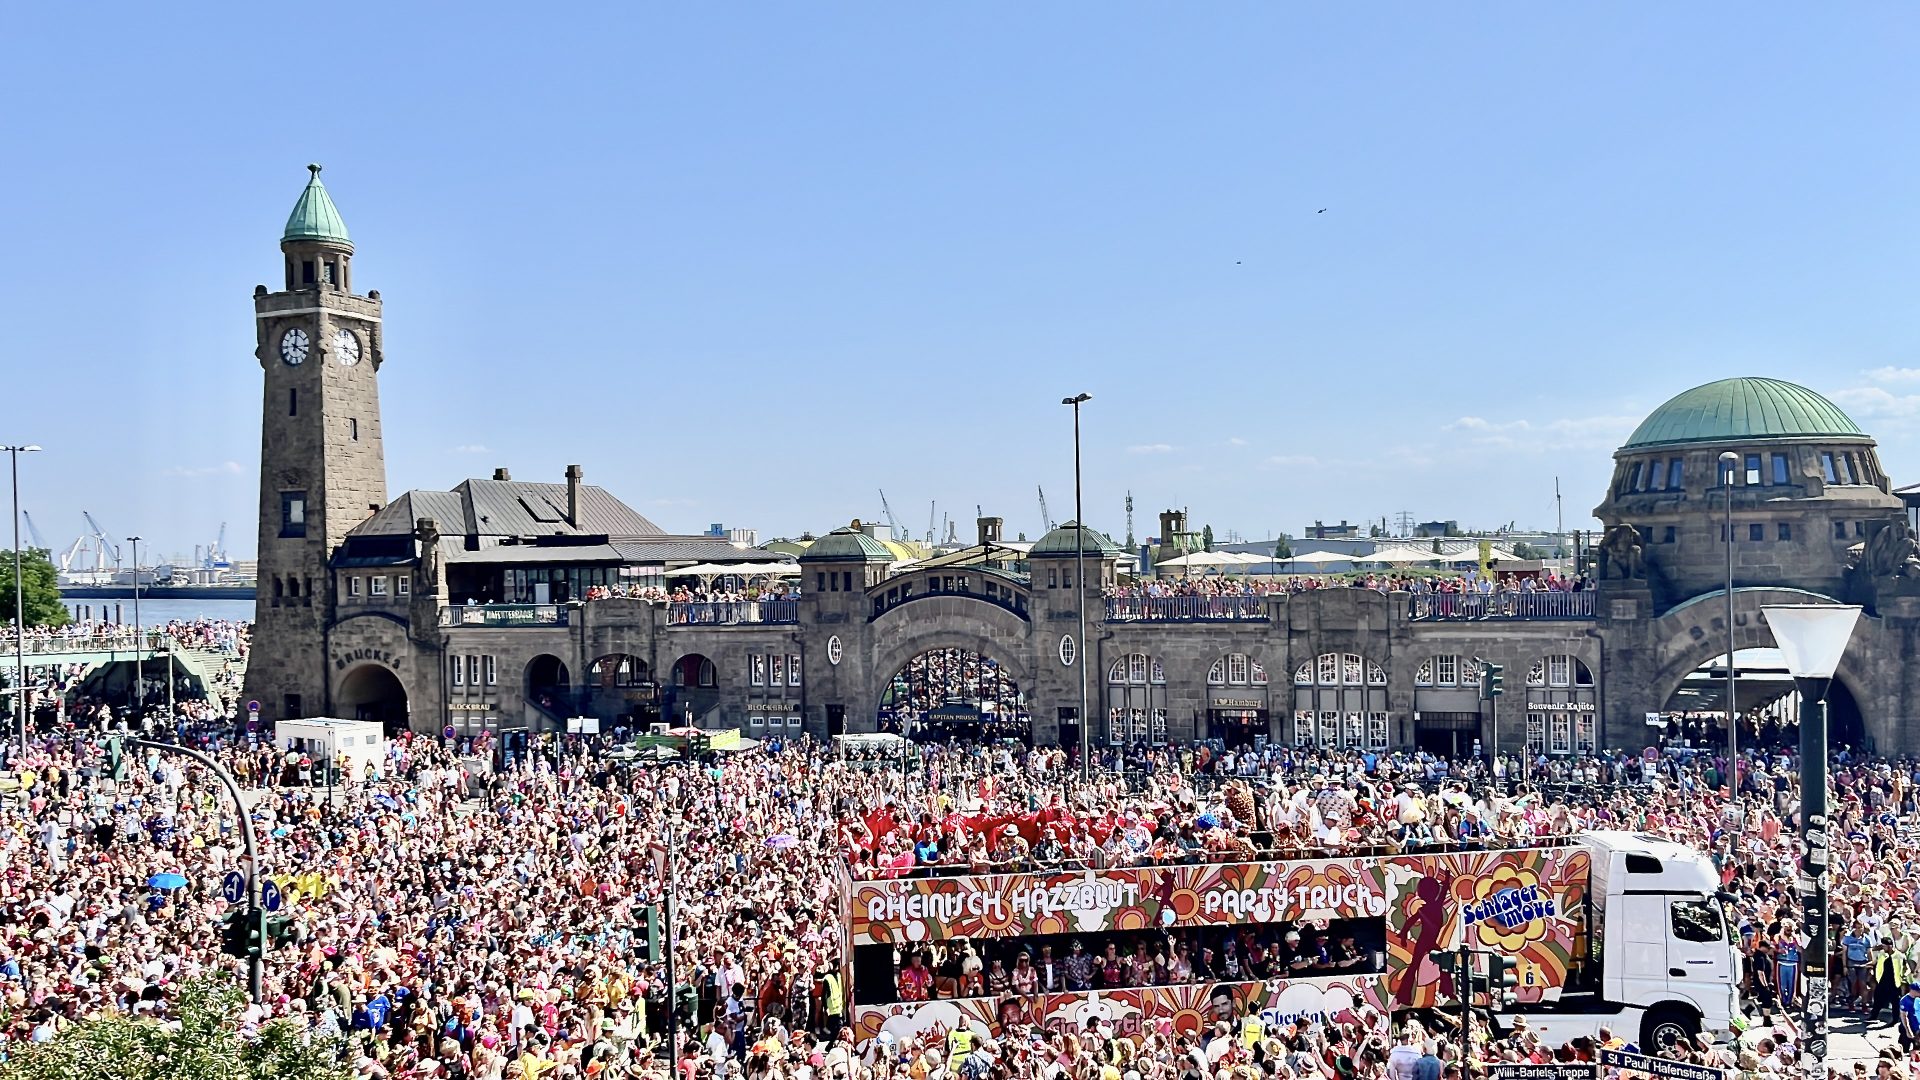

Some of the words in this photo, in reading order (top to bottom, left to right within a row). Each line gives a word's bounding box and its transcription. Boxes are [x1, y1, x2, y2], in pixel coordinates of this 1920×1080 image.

[1527, 702, 1564, 710] Souvenir
[868, 889, 1006, 926] RHEINISCH
[1463, 884, 1539, 925] Schlager
[1525, 972, 1534, 985] 6
[1494, 1066, 1590, 1078] Willi-Bartels-Treppe
[1607, 1054, 1621, 1065] St.
[1624, 1055, 1650, 1071] Pauli
[1653, 1061, 1717, 1080] Hafenstraße
